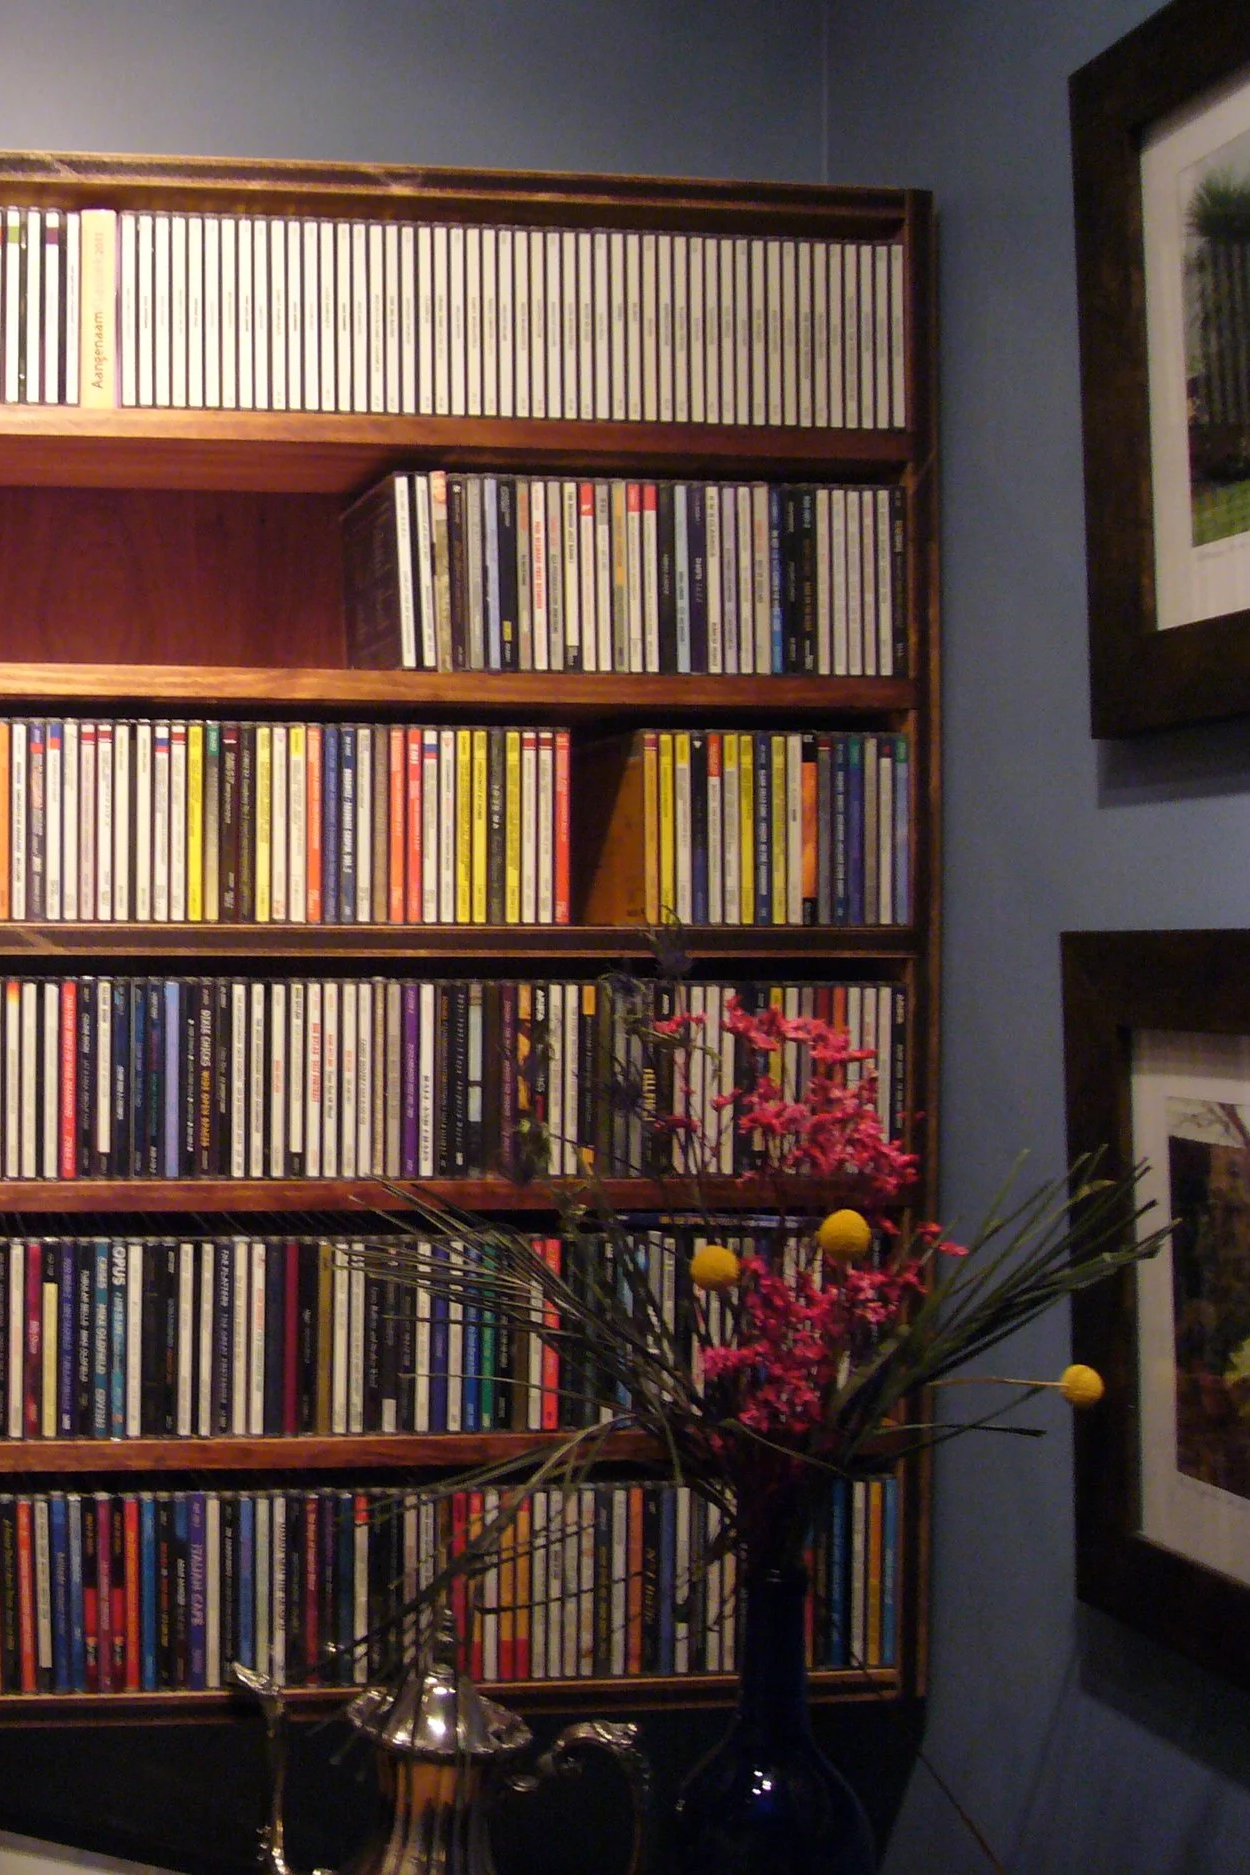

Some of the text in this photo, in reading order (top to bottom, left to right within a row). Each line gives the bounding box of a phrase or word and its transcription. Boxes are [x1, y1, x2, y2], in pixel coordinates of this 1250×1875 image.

[91, 311, 108, 388] Aangenaam
[200, 1008, 212, 1034] DIXIE
[200, 1036, 212, 1067] CHICKS
[111, 1244, 125, 1284] OPUS
